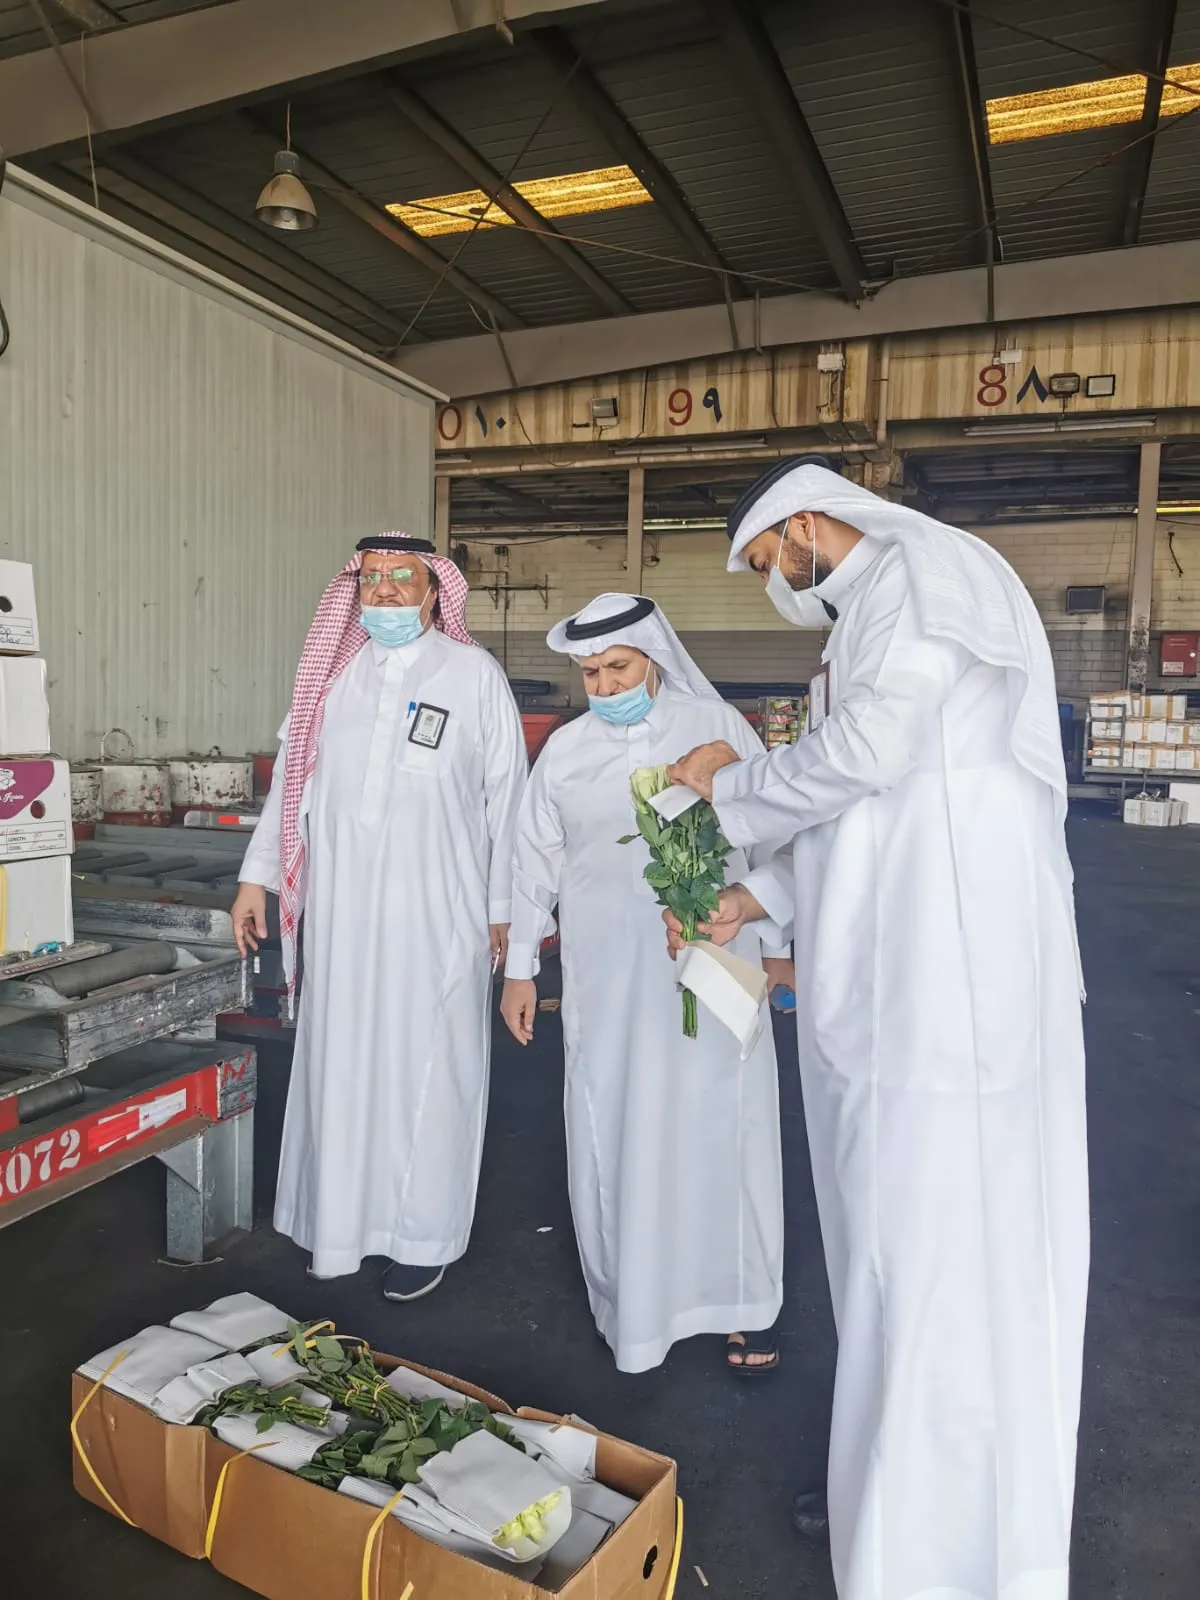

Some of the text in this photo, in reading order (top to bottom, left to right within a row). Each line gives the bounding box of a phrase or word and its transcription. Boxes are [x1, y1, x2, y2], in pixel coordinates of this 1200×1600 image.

[976, 364, 1007, 406] 8
[1016, 366, 1049, 404] ٨
[668, 388, 693, 426] 9
[703, 388, 724, 423] ٩
